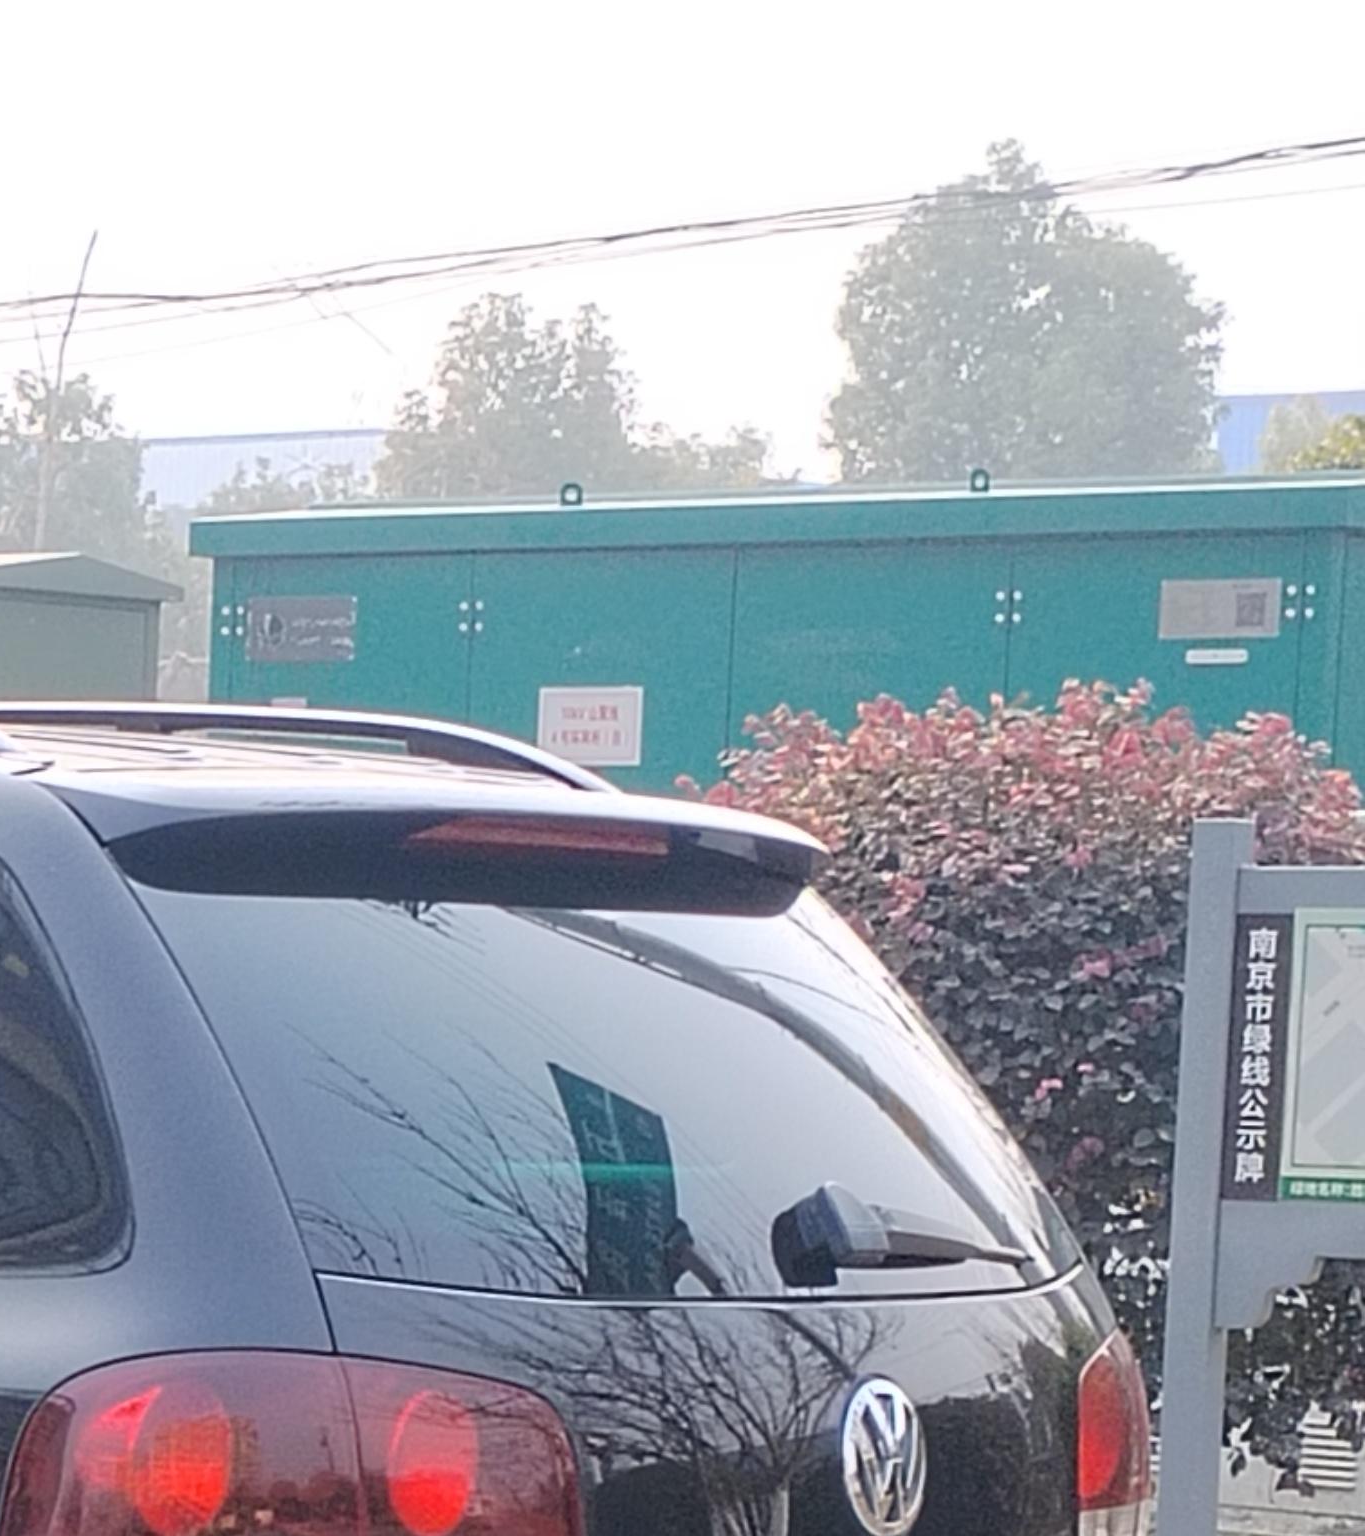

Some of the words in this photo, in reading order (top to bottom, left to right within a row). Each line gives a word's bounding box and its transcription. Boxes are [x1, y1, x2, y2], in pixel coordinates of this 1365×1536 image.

[1234, 927, 1279, 1184] 南京市绿线公示牌
